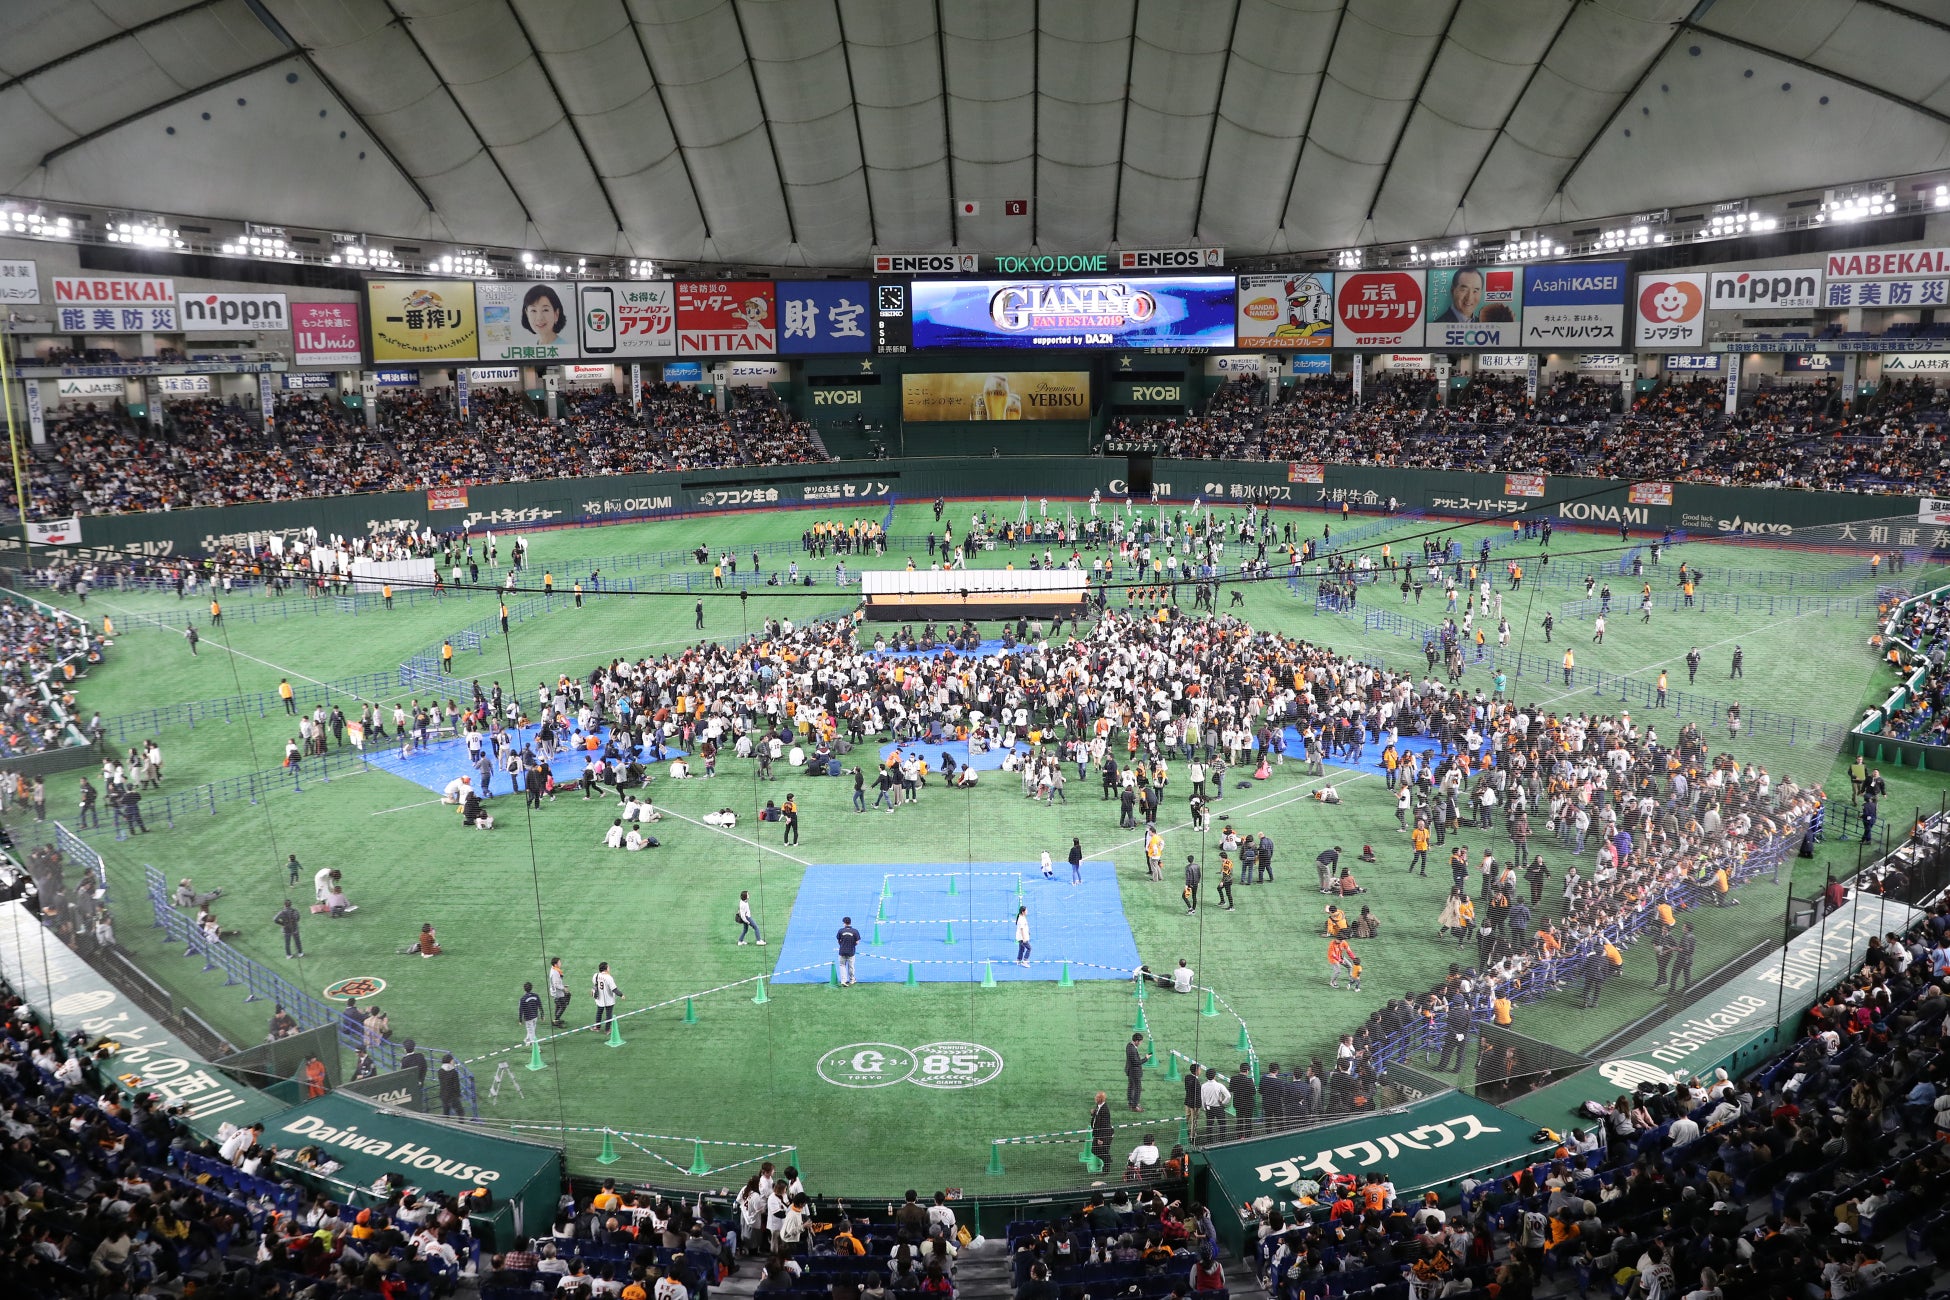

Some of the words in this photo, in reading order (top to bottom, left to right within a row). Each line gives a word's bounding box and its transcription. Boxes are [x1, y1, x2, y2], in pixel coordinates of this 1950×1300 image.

[892, 257, 954, 271] ENEOS
[995, 256, 1053, 273] TOKYO
[1057, 255, 1108, 272] DOME
[1138, 251, 1199, 267] ENEOS
[679, 284, 727, 293] 総合防災の
[1532, 276, 1618, 292] AsahiKASEI
[1716, 273, 1815, 303] nippn
[629, 292, 658, 302] お得な
[1361, 283, 1397, 300] 元気
[1829, 281, 1943, 306] 能美防災
[185, 295, 282, 324] nippn
[679, 296, 738, 312] ニッタン
[990, 284, 1130, 332] GIANTS
[1780, 298, 1813, 307] 日本製粉
[62, 309, 173, 330] 能美防災
[309, 308, 341, 318] ネットを
[386, 309, 462, 329] 一番搾り
[784, 299, 866, 339] 財宝
[301, 319, 352, 328] もっと快適に
[619, 315, 672, 335] アプリ
[879, 321, 885, 329] B
[1033, 316, 1051, 327] FAN
[1097, 316, 1123, 326] 2019
[1445, 331, 1500, 345] SECOM
[1530, 326, 1614, 338] ヘーベルハウス
[1644, 326, 1693, 340] シマダヤ
[681, 333, 773, 351] NITTAN
[1033, 336, 1071, 345] supported
[1074, 337, 1083, 345] by
[1085, 334, 1113, 344] DAZN
[1355, 336, 1402, 344] オロナミンC
[501, 346, 559, 358] JR東日本
[1482, 356, 1525, 366] 昭和大学
[1667, 356, 1718, 369] 日総工産
[1908, 361, 1949, 369] JA共済
[1269, 366, 1278, 374] 34
[1440, 367, 1445, 375] 3
[366, 385, 374, 393] 14
[1036, 382, 1076, 393] Premium
[1132, 387, 1180, 400] RYOBI
[813, 390, 862, 405] RYOBI
[1028, 394, 1084, 407] YEBISU
[1108, 443, 1158, 451] 日本アンテナ
[1534, 476, 1544, 486] A
[716, 488, 779, 505] フコク生命
[804, 485, 840, 493] 守りの名手
[843, 483, 889, 497] セノン
[1230, 484, 1291, 500] 積水ハウス
[1317, 487, 1379, 505] 大樹生命
[1662, 485, 1671, 494] B
[624, 496, 672, 511] OIZUMI
[468, 507, 562, 526] アートネイチャー
[1559, 503, 1648, 525] KONAMI
[1700, 521, 1713, 529] life.
[1839, 525, 1950, 548] 大和証券
[1651, 994, 1767, 1065] nishikawa
[923, 1055, 979, 1075] 85
[281, 1115, 393, 1160] Daiwa
[384, 1142, 500, 1186] House
[1255, 1114, 1502, 1188] ダイワハウス
